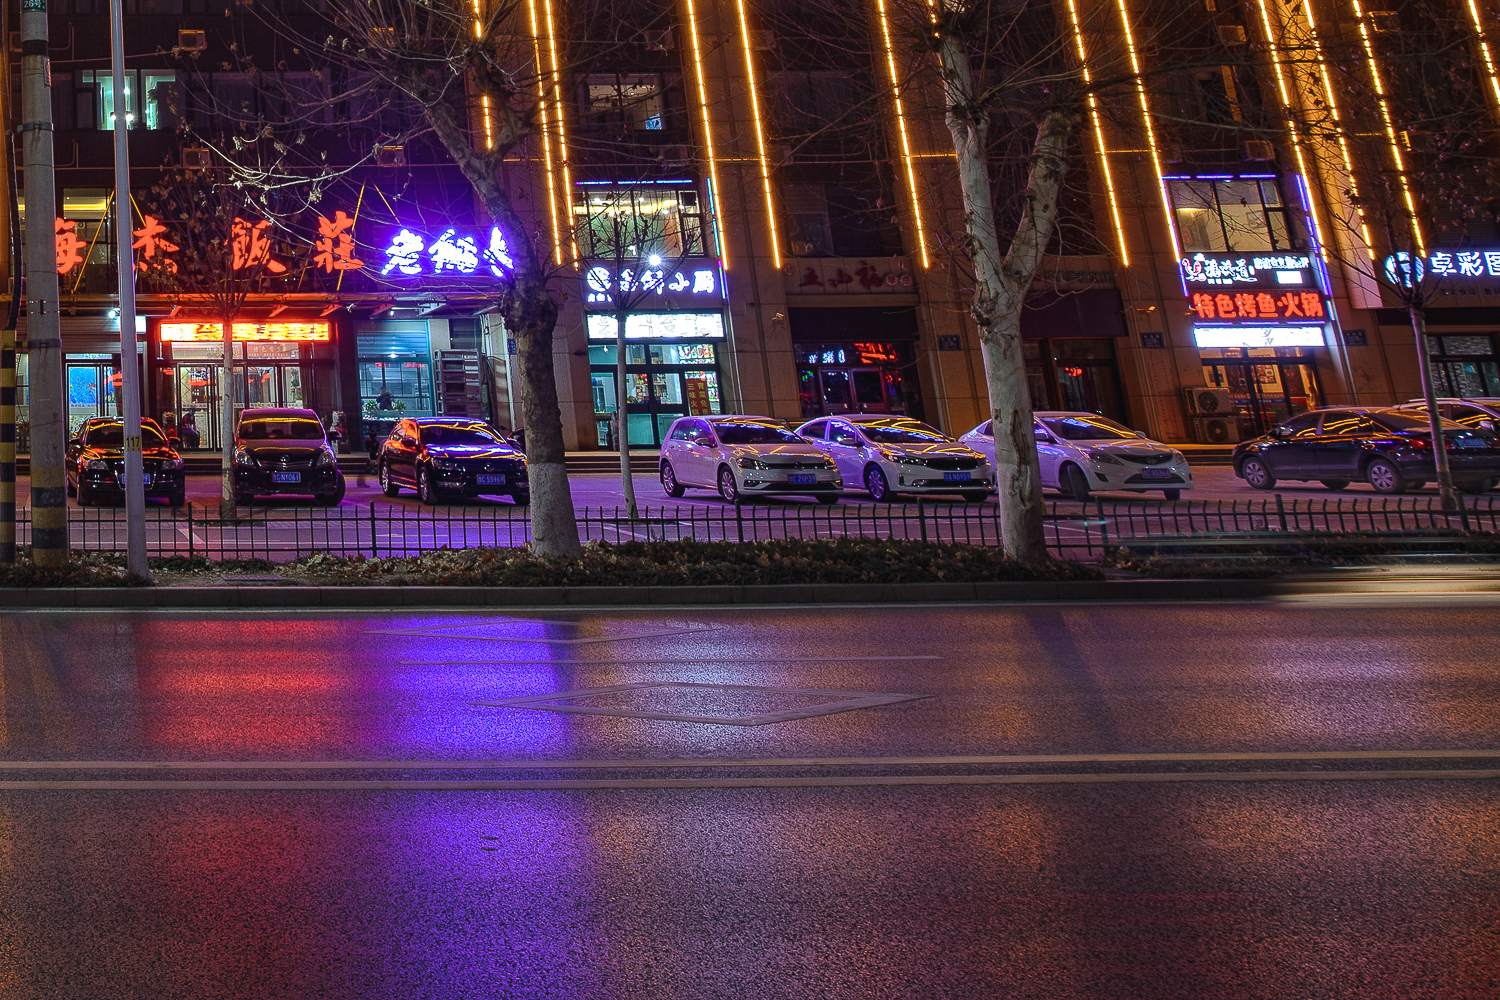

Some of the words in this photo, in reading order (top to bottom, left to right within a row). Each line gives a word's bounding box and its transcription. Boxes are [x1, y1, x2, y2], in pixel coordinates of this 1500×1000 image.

[1193, 292, 1324, 319] 特色烤鱼·火锅
[125, 437, 140, 448] 117
